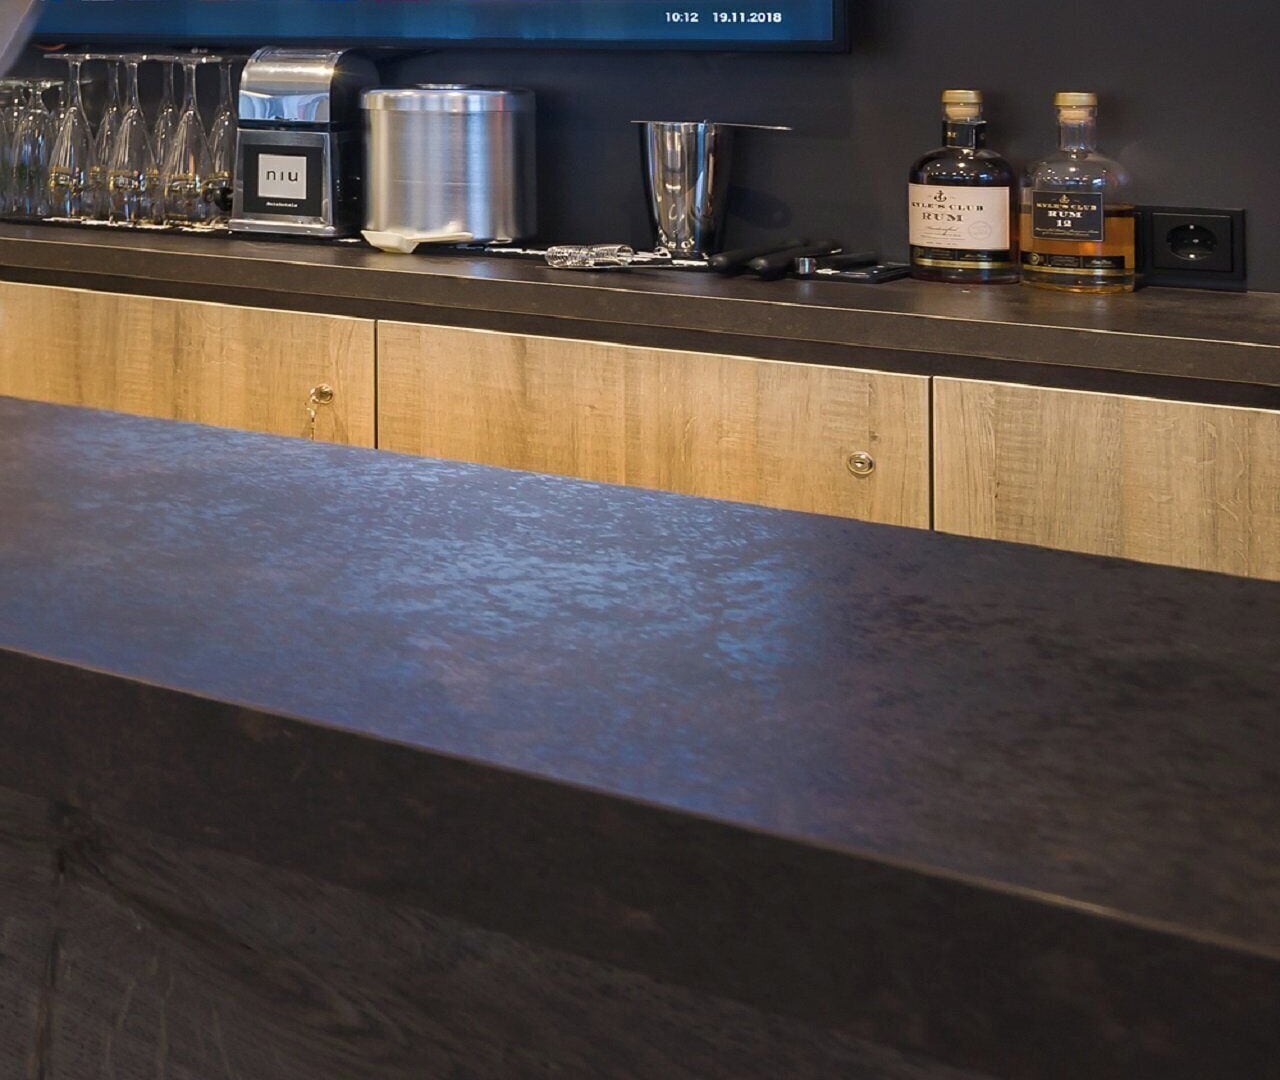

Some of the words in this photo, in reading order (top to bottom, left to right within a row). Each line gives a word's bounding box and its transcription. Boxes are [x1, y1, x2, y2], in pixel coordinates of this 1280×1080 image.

[665, 11, 699, 23] 10:12
[712, 11, 782, 23] 19.11.2018
[266, 170, 298, 182] niu
[922, 212, 964, 222] RUM
[1047, 210, 1083, 218] RUM
[1056, 219, 1072, 227] 12
